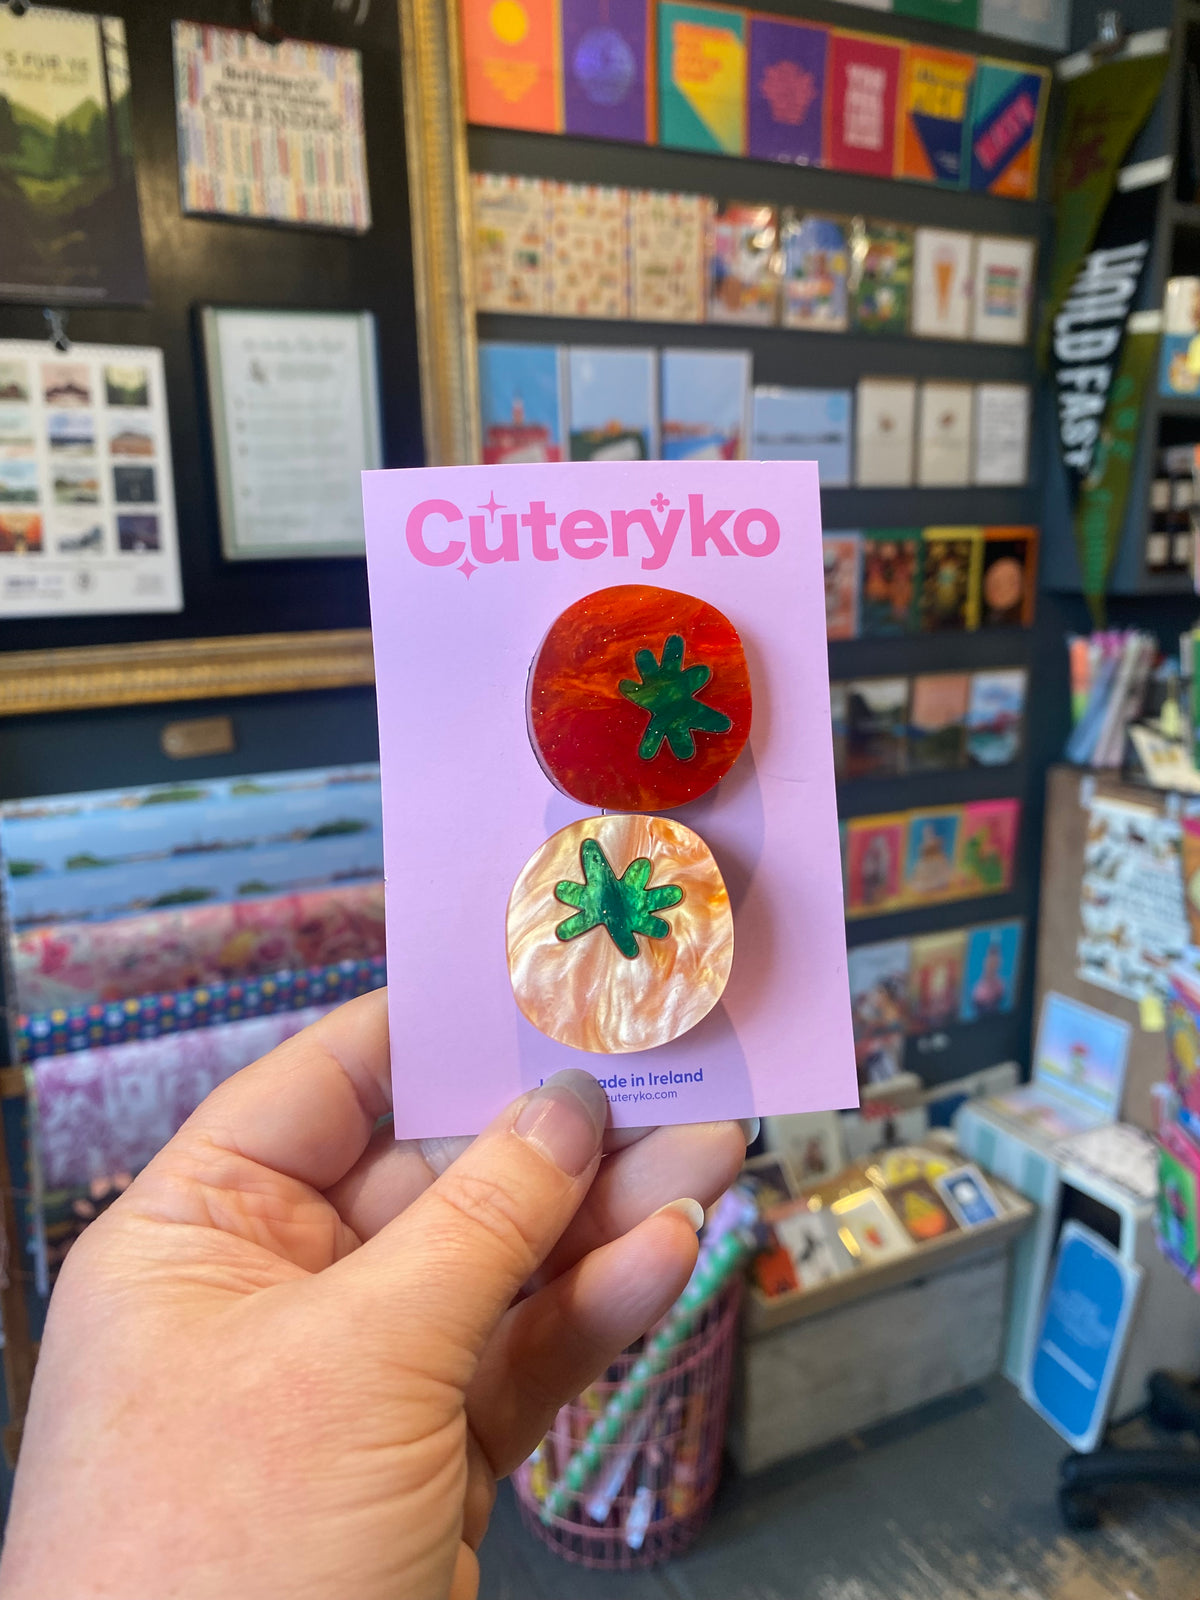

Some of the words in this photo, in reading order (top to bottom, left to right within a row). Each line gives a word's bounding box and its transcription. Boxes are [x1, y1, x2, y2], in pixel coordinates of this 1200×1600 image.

[1056, 364, 1113, 470] FAST
[405, 493, 781, 571] Cuteryko
[631, 1073, 645, 1087] in
[648, 1068, 704, 1086] Ireland
